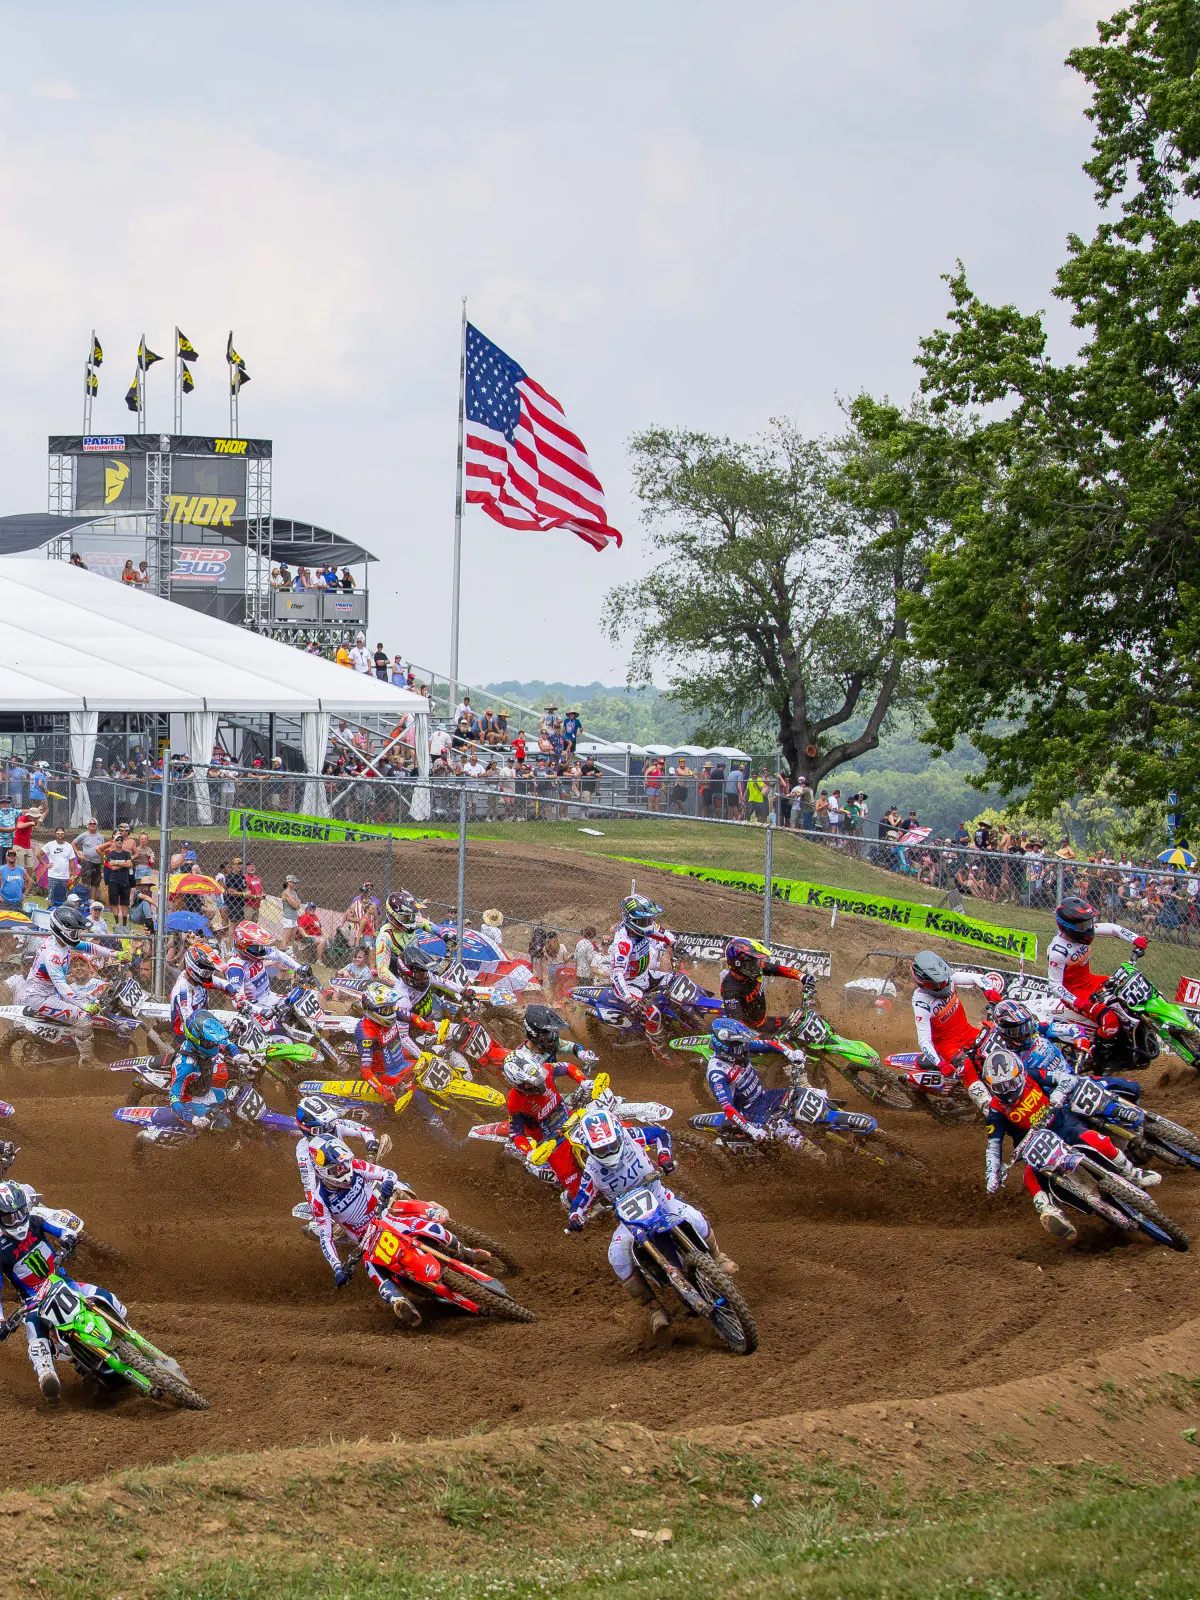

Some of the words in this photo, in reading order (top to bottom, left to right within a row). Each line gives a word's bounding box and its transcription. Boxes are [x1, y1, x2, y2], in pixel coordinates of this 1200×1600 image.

[84, 436, 125, 446] PARTS
[214, 438, 248, 455] THOR
[165, 495, 237, 527] THOR
[170, 546, 232, 562] RED
[239, 812, 331, 841] Kawasaki
[807, 888, 912, 925] Kawasaki
[925, 911, 1029, 953] Kawasaki
[126, 982, 143, 1007] 233
[674, 976, 696, 1002] 3
[1121, 972, 1152, 1007] 535
[300, 994, 321, 1019] 146
[606, 1010, 625, 1026] 3
[36, 1026, 60, 1040] 233
[247, 1027, 264, 1052] 78
[469, 1027, 490, 1058] 417
[428, 1061, 450, 1090] 45
[242, 1088, 264, 1121] 82
[799, 1090, 823, 1123] 103
[1075, 1081, 1101, 1115] 53
[1028, 1131, 1060, 1166] 992
[538, 1169, 556, 1183] 102
[609, 1158, 644, 1192] FXR
[622, 1190, 653, 1220] 37
[375, 1231, 400, 1265] 18
[44, 1286, 78, 1325] 70
